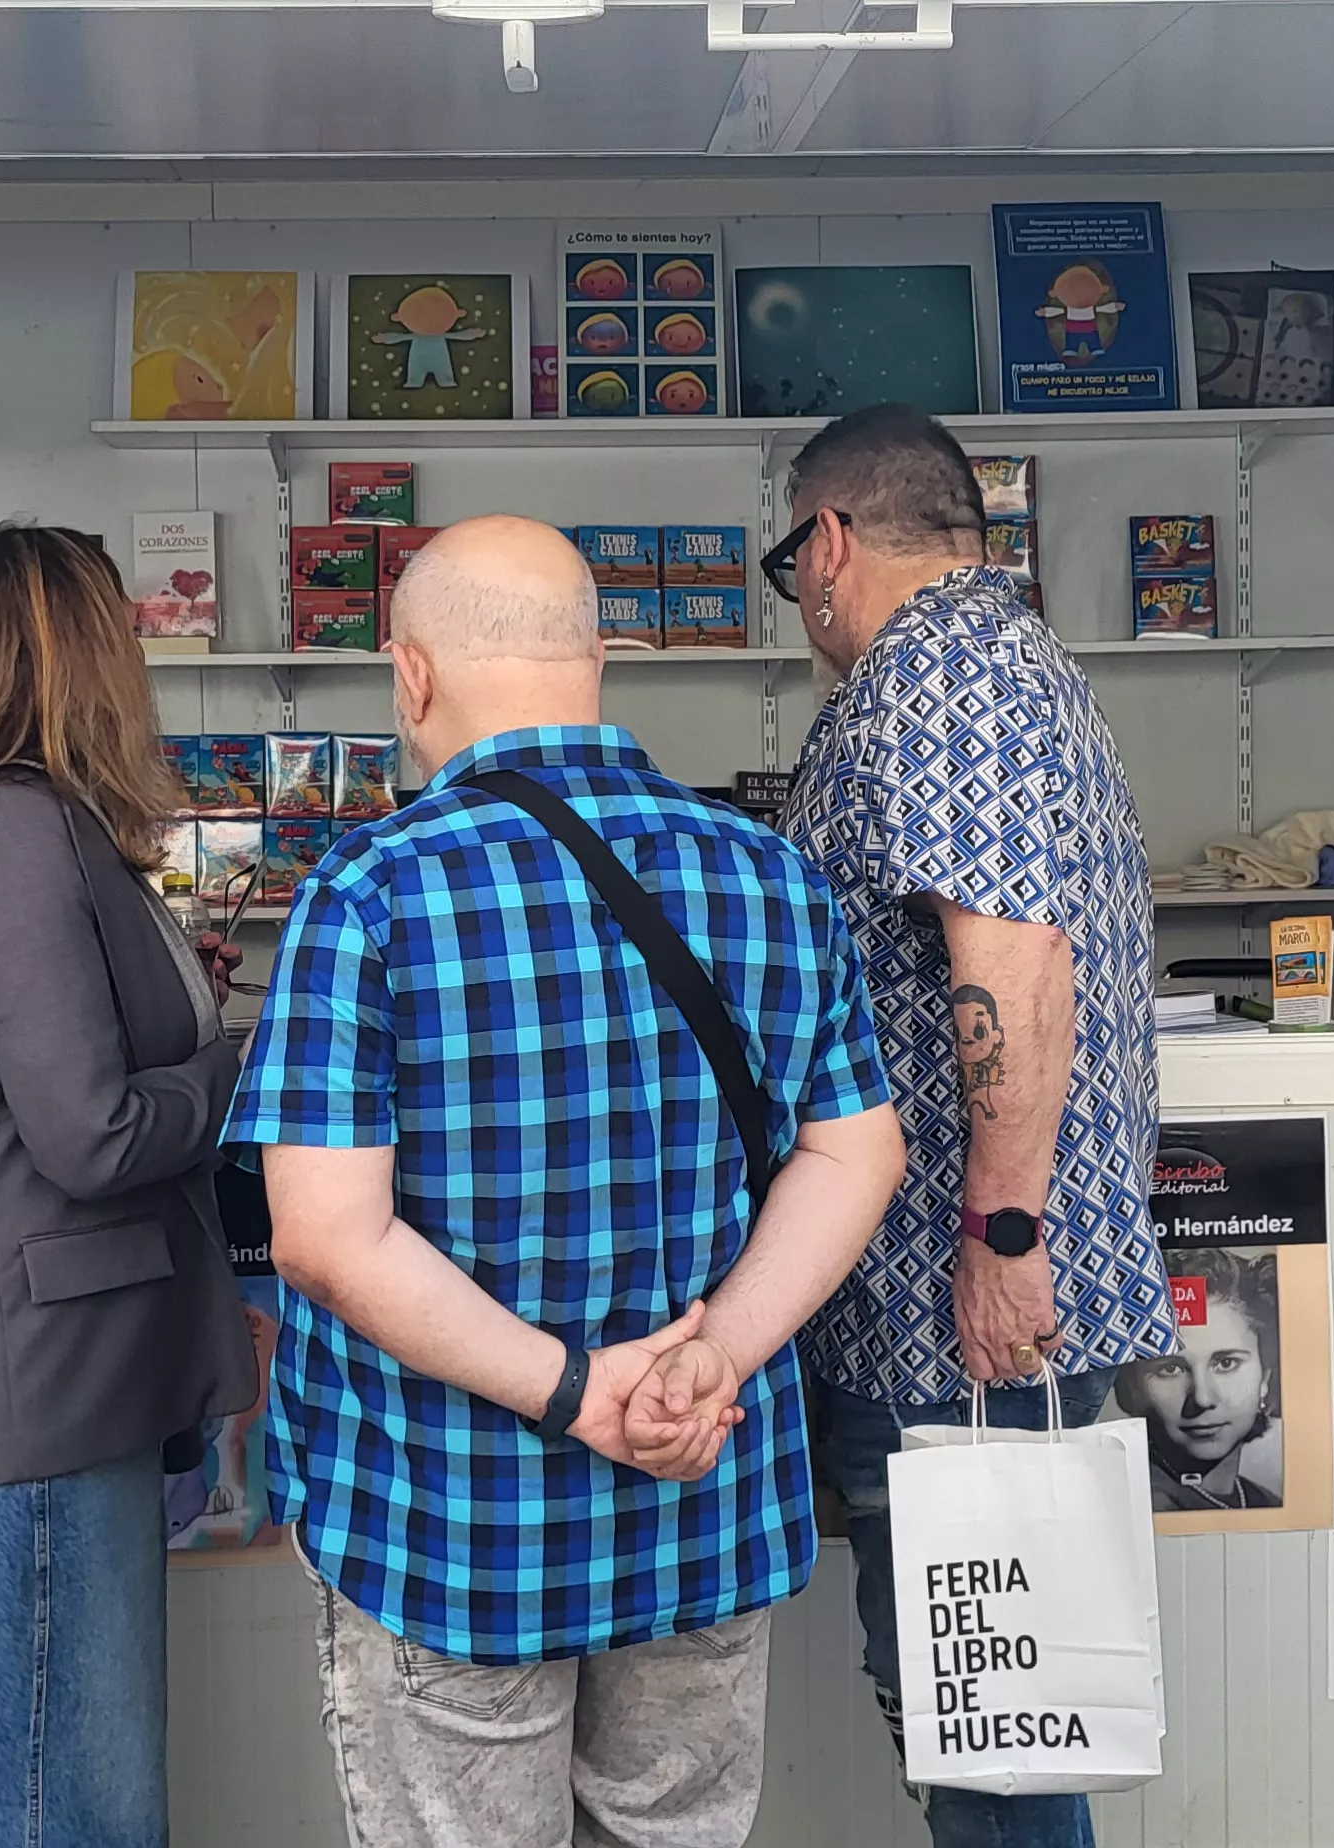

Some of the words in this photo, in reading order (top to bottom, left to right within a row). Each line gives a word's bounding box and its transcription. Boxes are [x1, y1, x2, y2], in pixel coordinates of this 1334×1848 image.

[567, 232, 612, 244] ¿Cómo
[616, 233, 628, 243] te
[631, 232, 676, 243] sientes
[680, 232, 712, 245] hoy?
[161, 524, 185, 534] DOS
[1138, 520, 1196, 545] BASKET
[139, 537, 208, 547] CORAZONES
[599, 533, 637, 546] TENNIS
[685, 533, 722, 546] TENNIS
[685, 544, 722, 556] CARDS
[685, 596, 723, 608] TENNIS
[1141, 583, 1201, 609] BASKET
[601, 597, 638, 609] TENNIS
[686, 607, 723, 619] CARDS
[747, 777, 761, 787] EL
[747, 790, 771, 800] DEL
[1278, 932, 1310, 946] MARCA
[1150, 1179, 1230, 1195] Editorial
[1174, 1214, 1294, 1237] Hernández
[926, 1558, 1030, 1600] FERIA
[929, 1599, 995, 1639] DEL
[932, 1634, 1038, 1678] LIBRO
[935, 1677, 981, 1715] DE
[938, 1712, 1090, 1755] HUESCA
